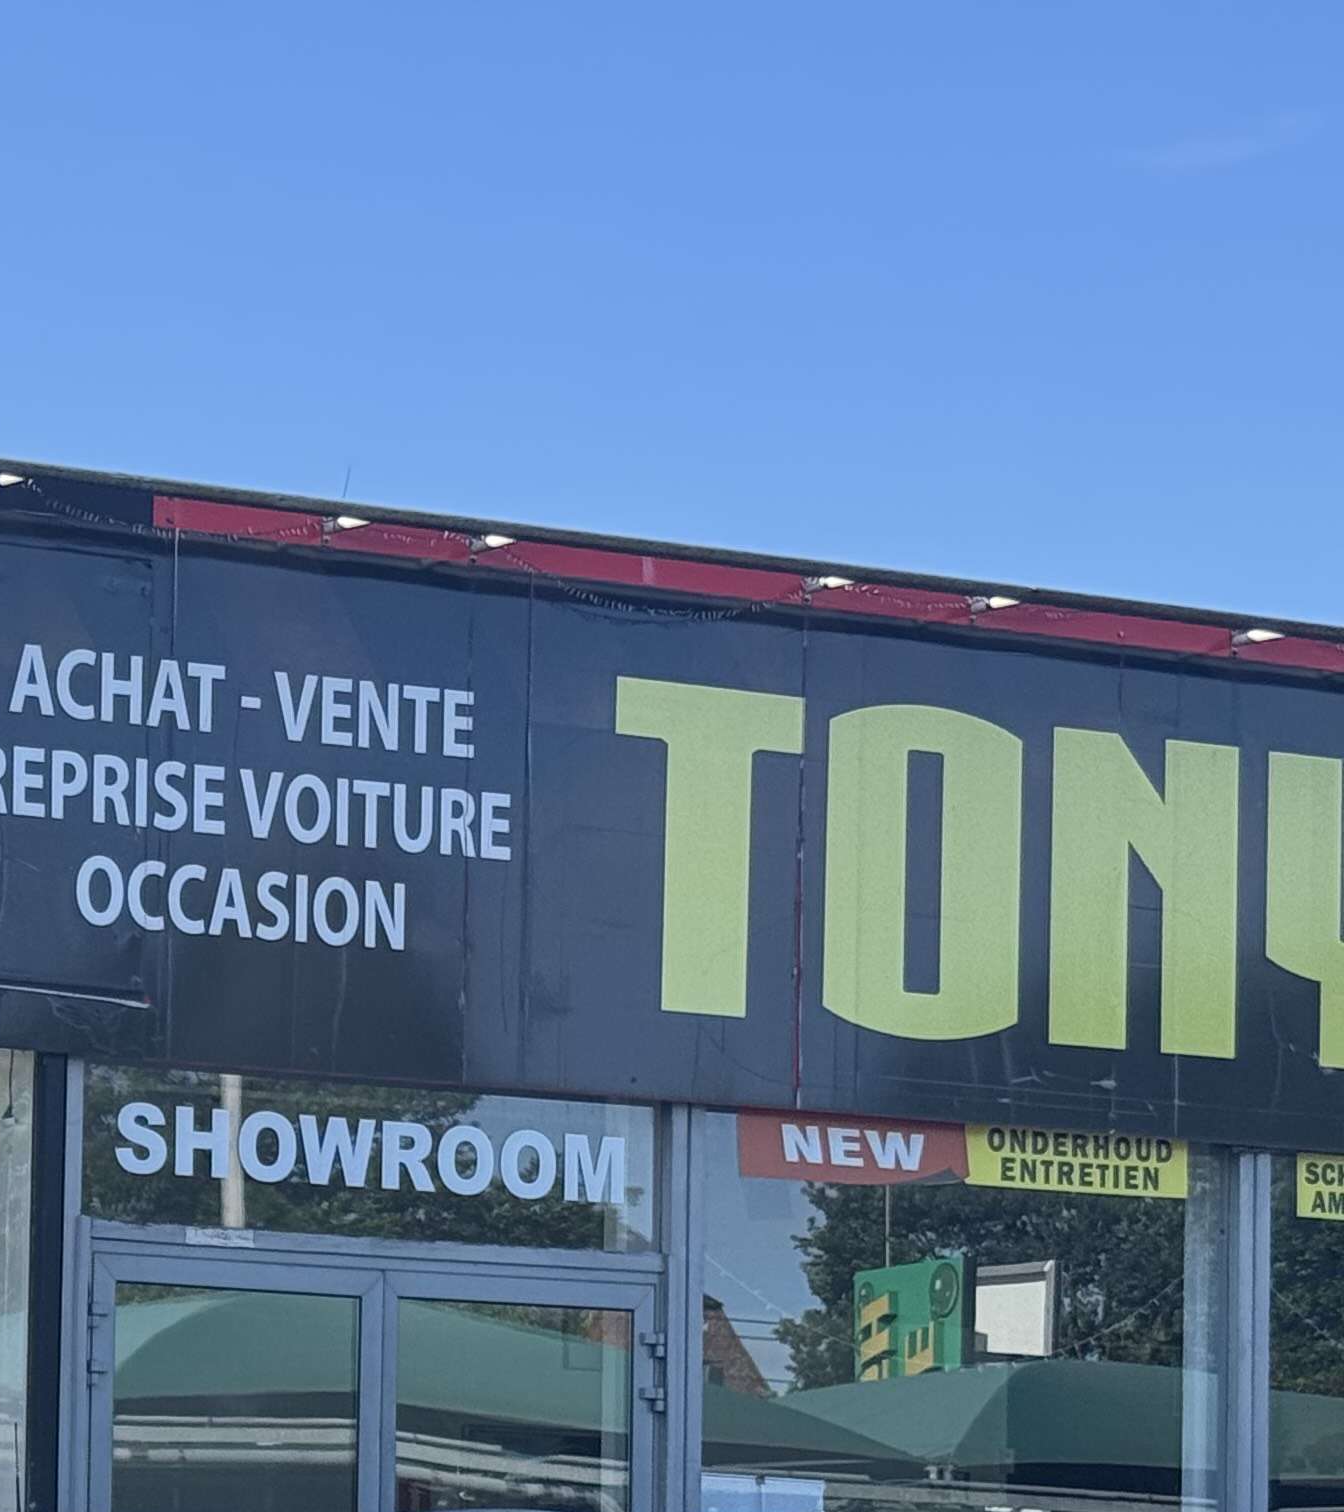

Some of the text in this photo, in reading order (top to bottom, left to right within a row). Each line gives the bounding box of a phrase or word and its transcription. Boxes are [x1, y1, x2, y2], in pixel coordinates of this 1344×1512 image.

[8, 643, 227, 733] ACHAT
[274, 670, 476, 759] VENTE
[239, 767, 513, 862] VOITURE
[75, 854, 407, 952] OCCASION
[114, 1102, 627, 1205] SHOWROOM
[780, 1123, 925, 1172] NEW
[987, 1126, 1173, 1164] ONDERHOUD
[999, 1156, 1161, 1192] ENTRETIEN
